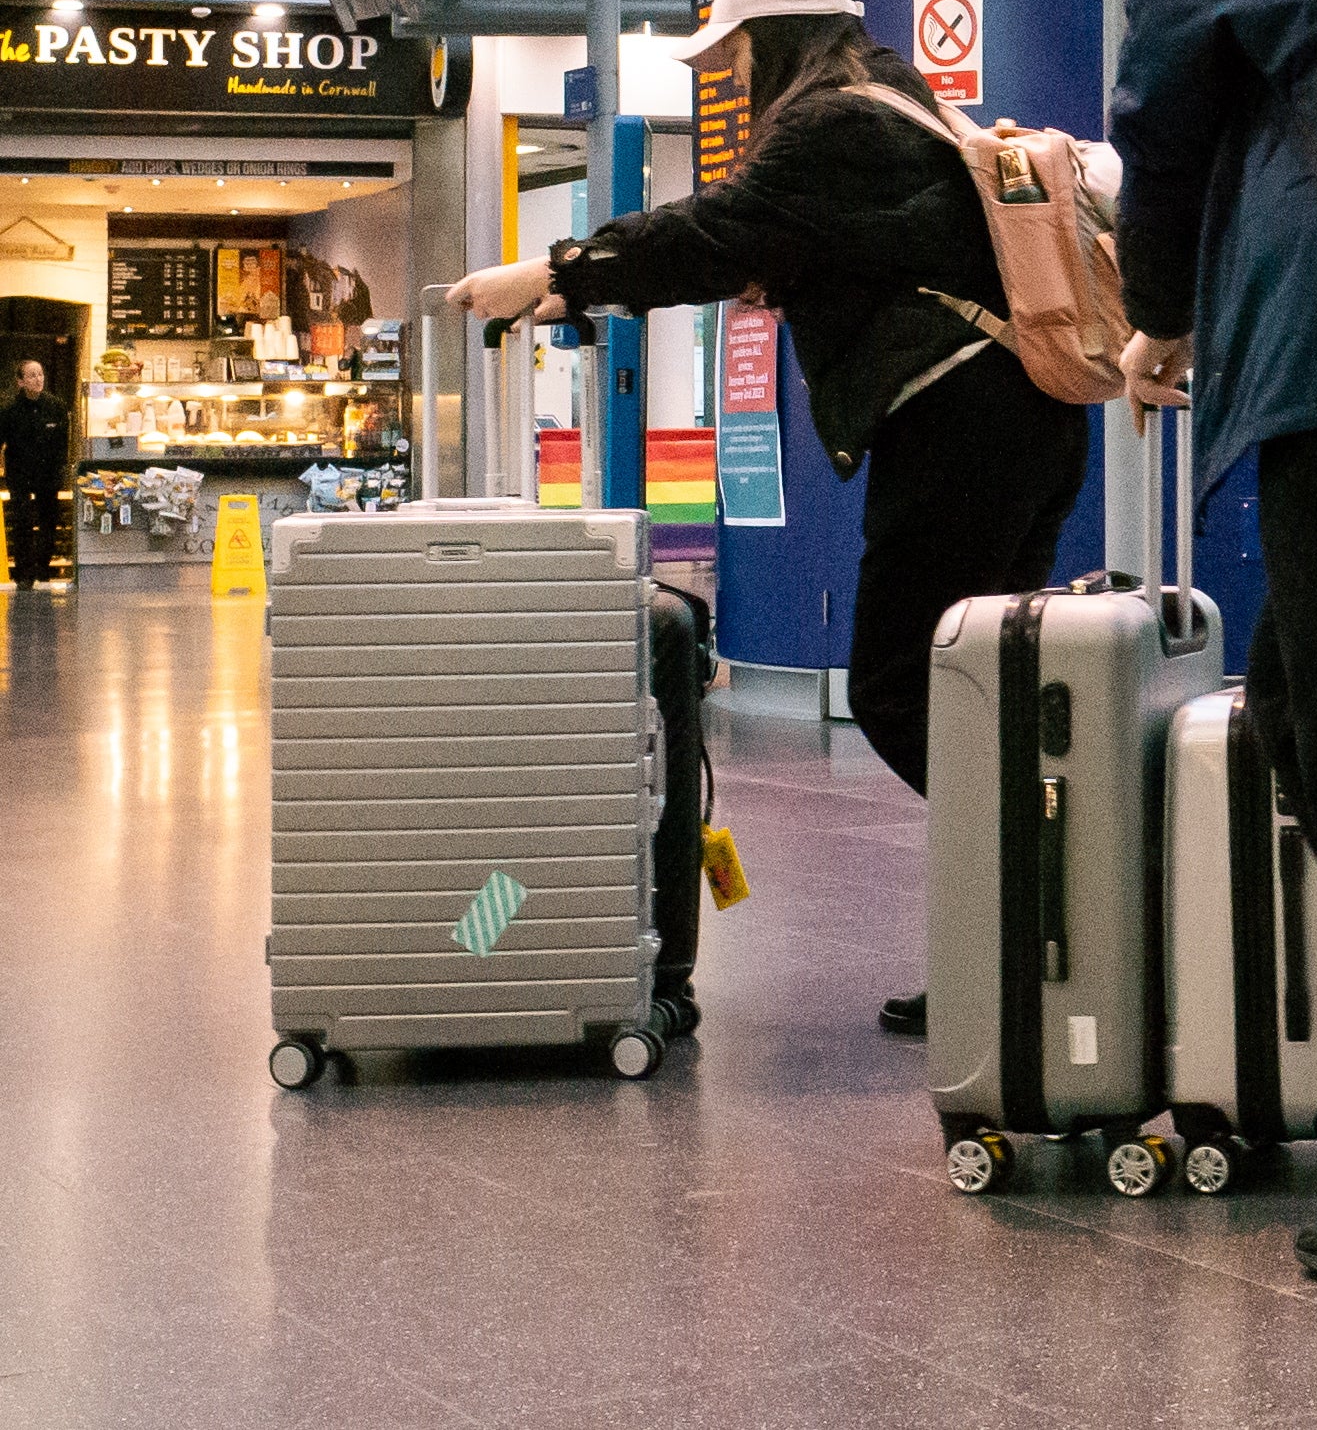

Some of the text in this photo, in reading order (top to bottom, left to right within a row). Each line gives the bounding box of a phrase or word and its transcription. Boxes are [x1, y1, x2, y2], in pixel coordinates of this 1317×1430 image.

[34, 24, 216, 67] PASTY
[232, 31, 378, 70] SHOP
[227, 75, 377, 98] Handmade in Cornwall
[941, 75, 954, 85] No
[934, 88, 966, 98] moking
